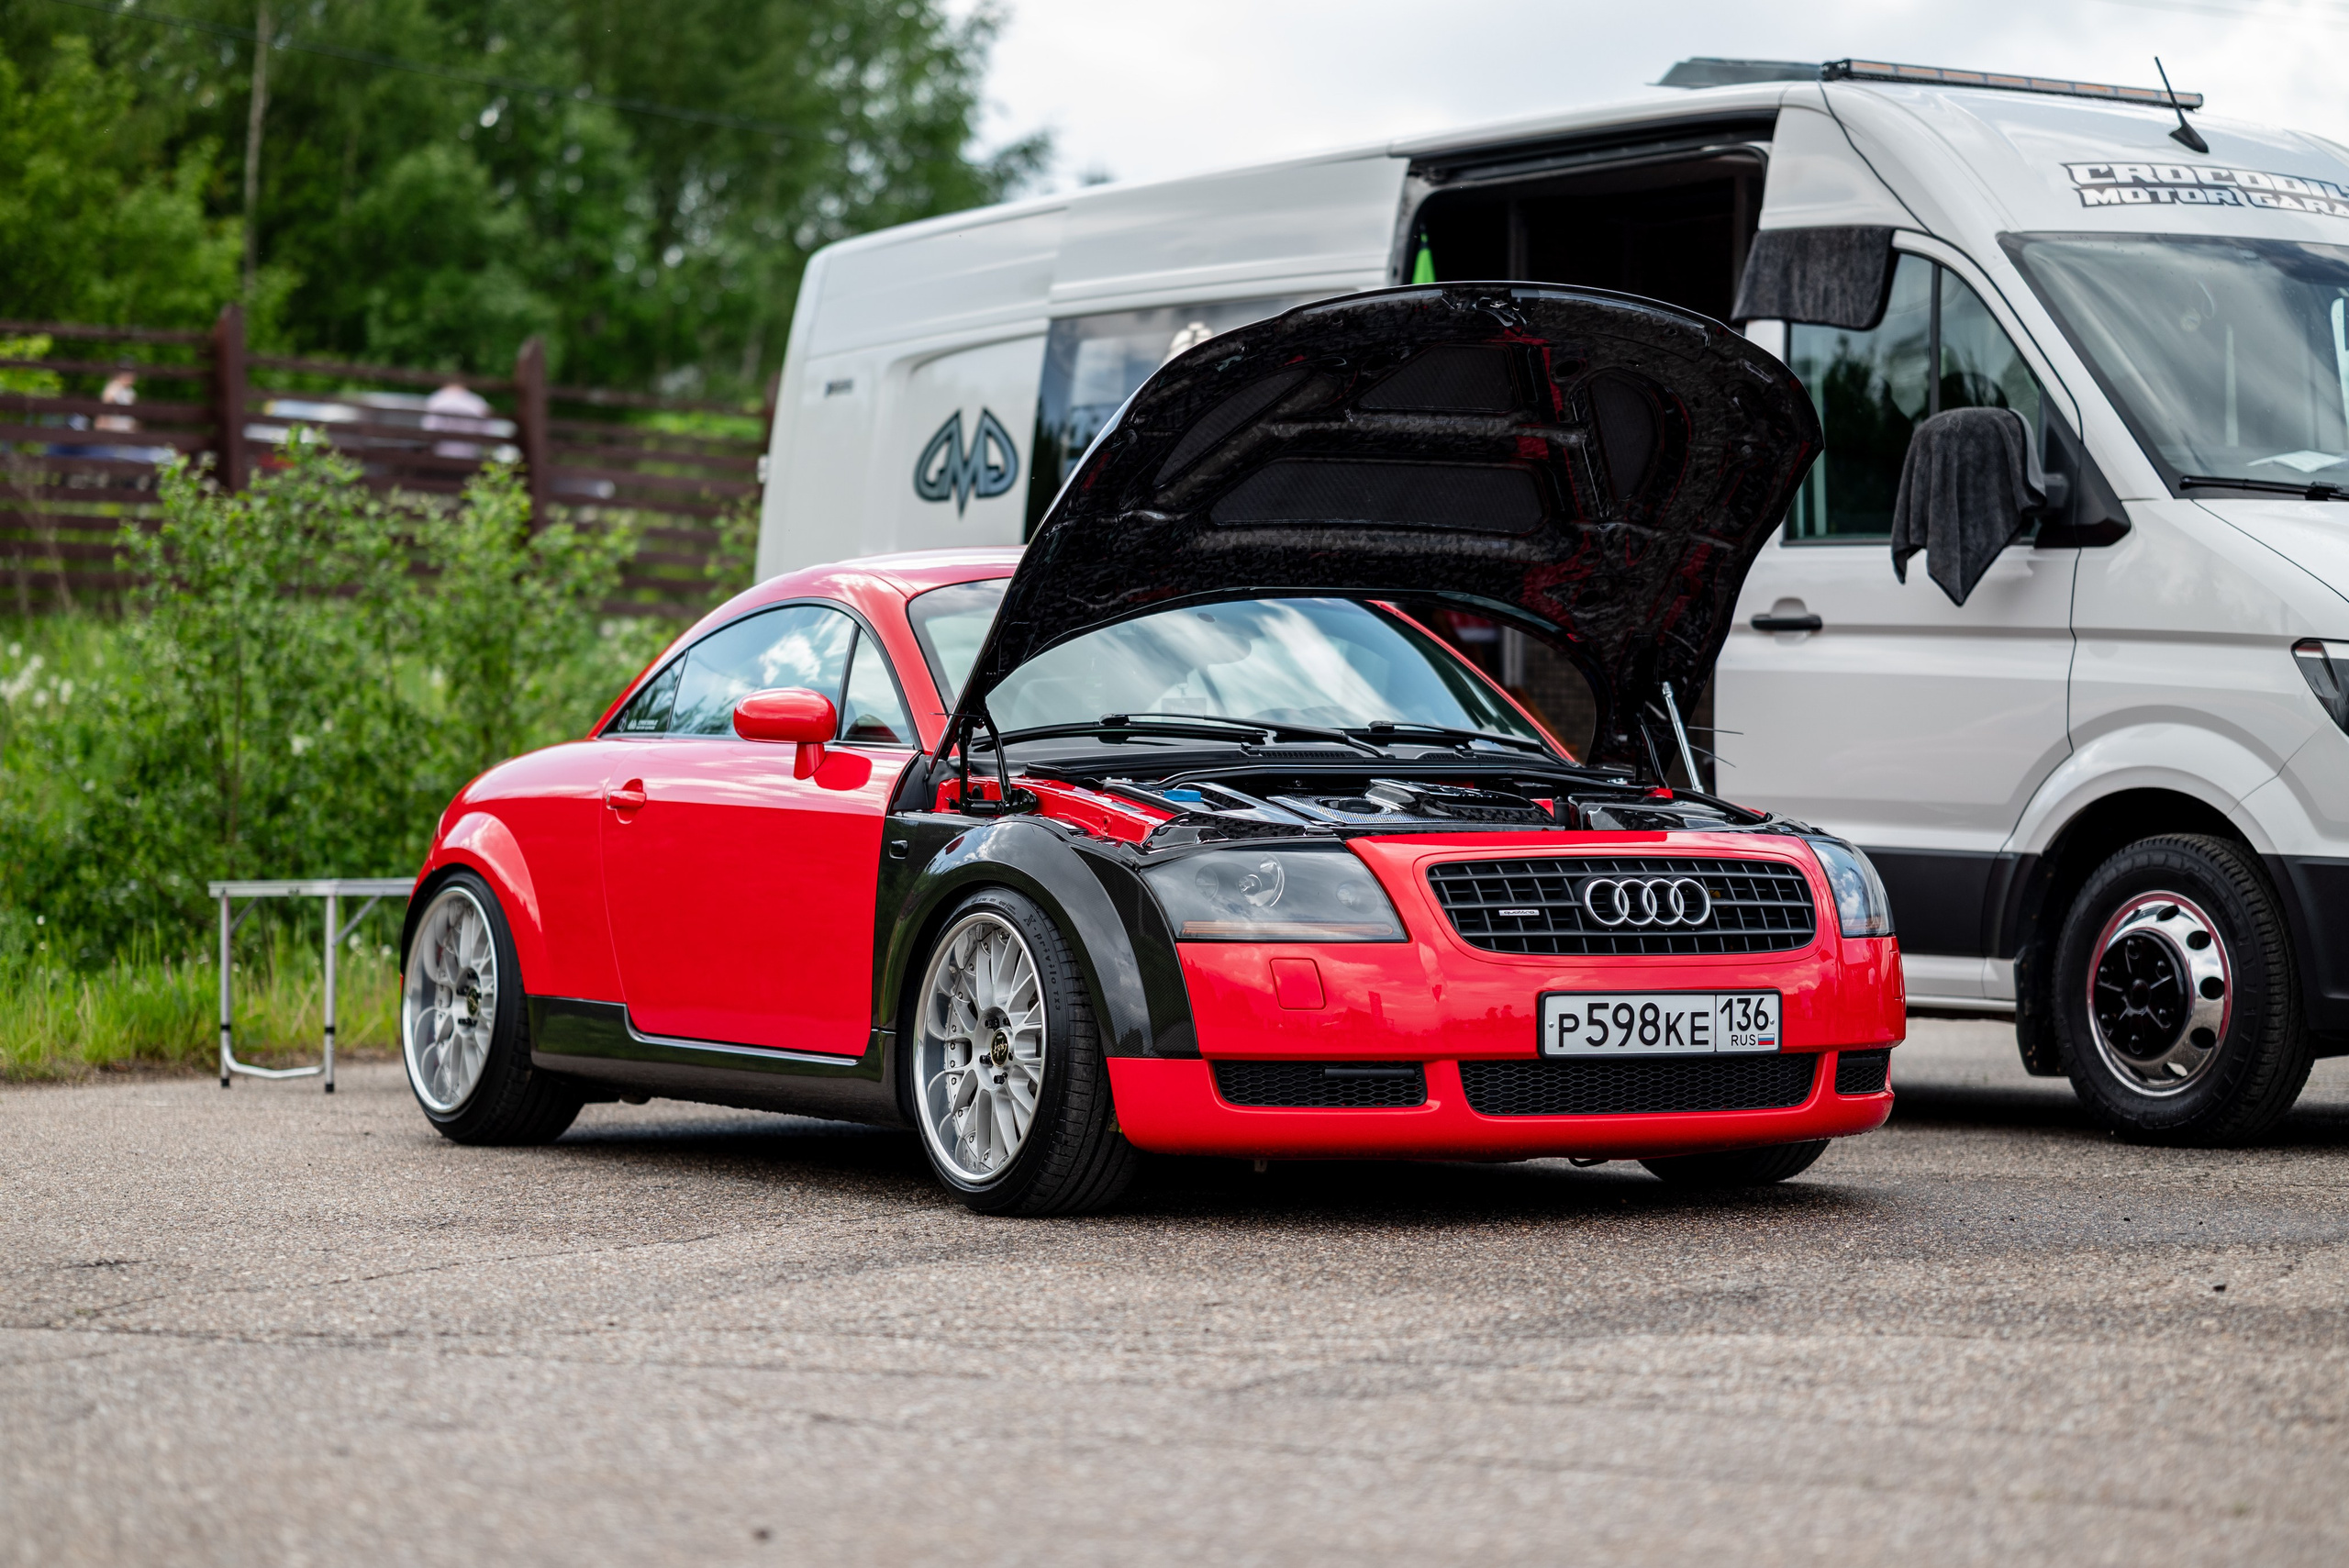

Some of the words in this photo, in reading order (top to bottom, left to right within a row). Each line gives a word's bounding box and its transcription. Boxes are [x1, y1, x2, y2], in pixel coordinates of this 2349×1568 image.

[2061, 161, 2349, 203] CROCODIL
[2074, 186, 2244, 207] MOTOR
[1720, 997, 1769, 1032] 136
[1731, 1034, 1756, 1047] RUS
